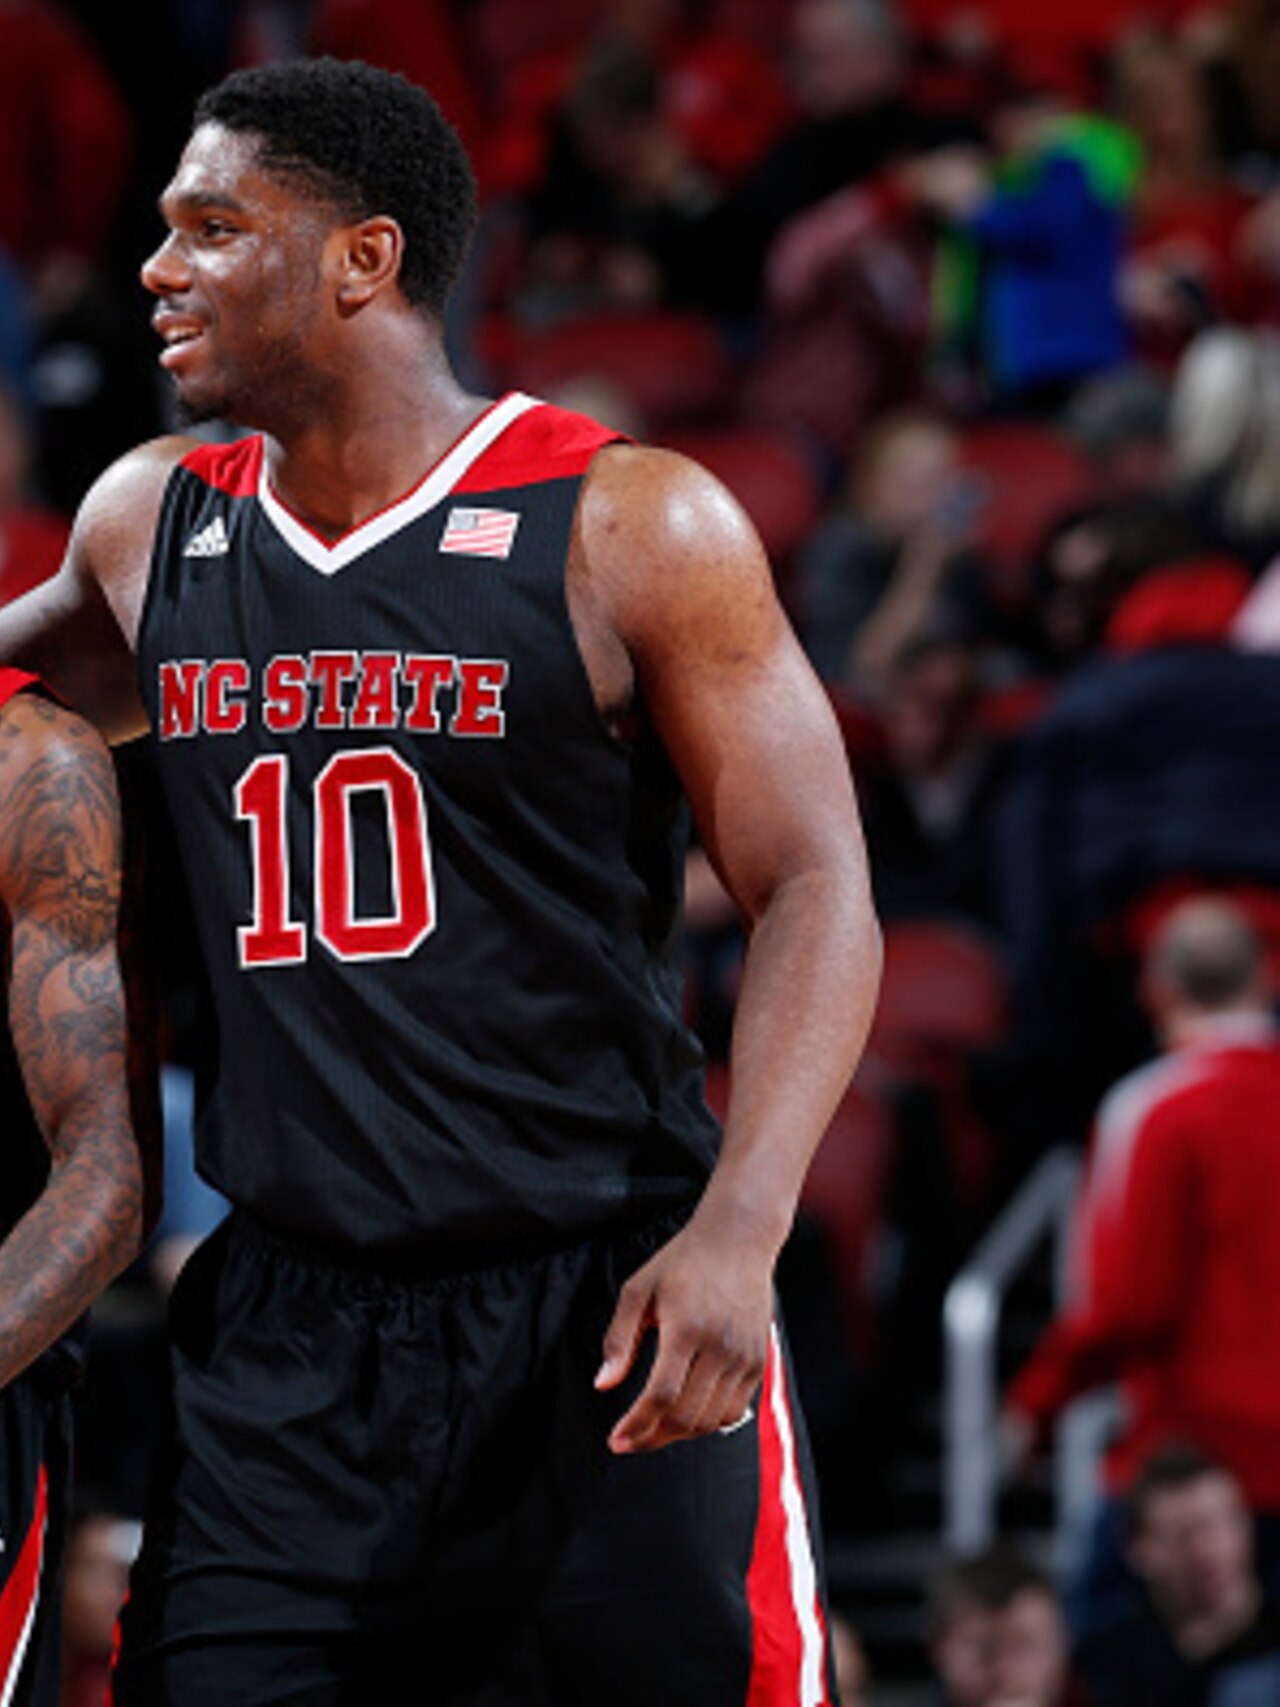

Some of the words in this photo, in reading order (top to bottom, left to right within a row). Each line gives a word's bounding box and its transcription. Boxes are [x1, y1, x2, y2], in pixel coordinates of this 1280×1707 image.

[159, 659, 249, 740] NC
[263, 651, 509, 738] STATE
[234, 745, 437, 969] 10
